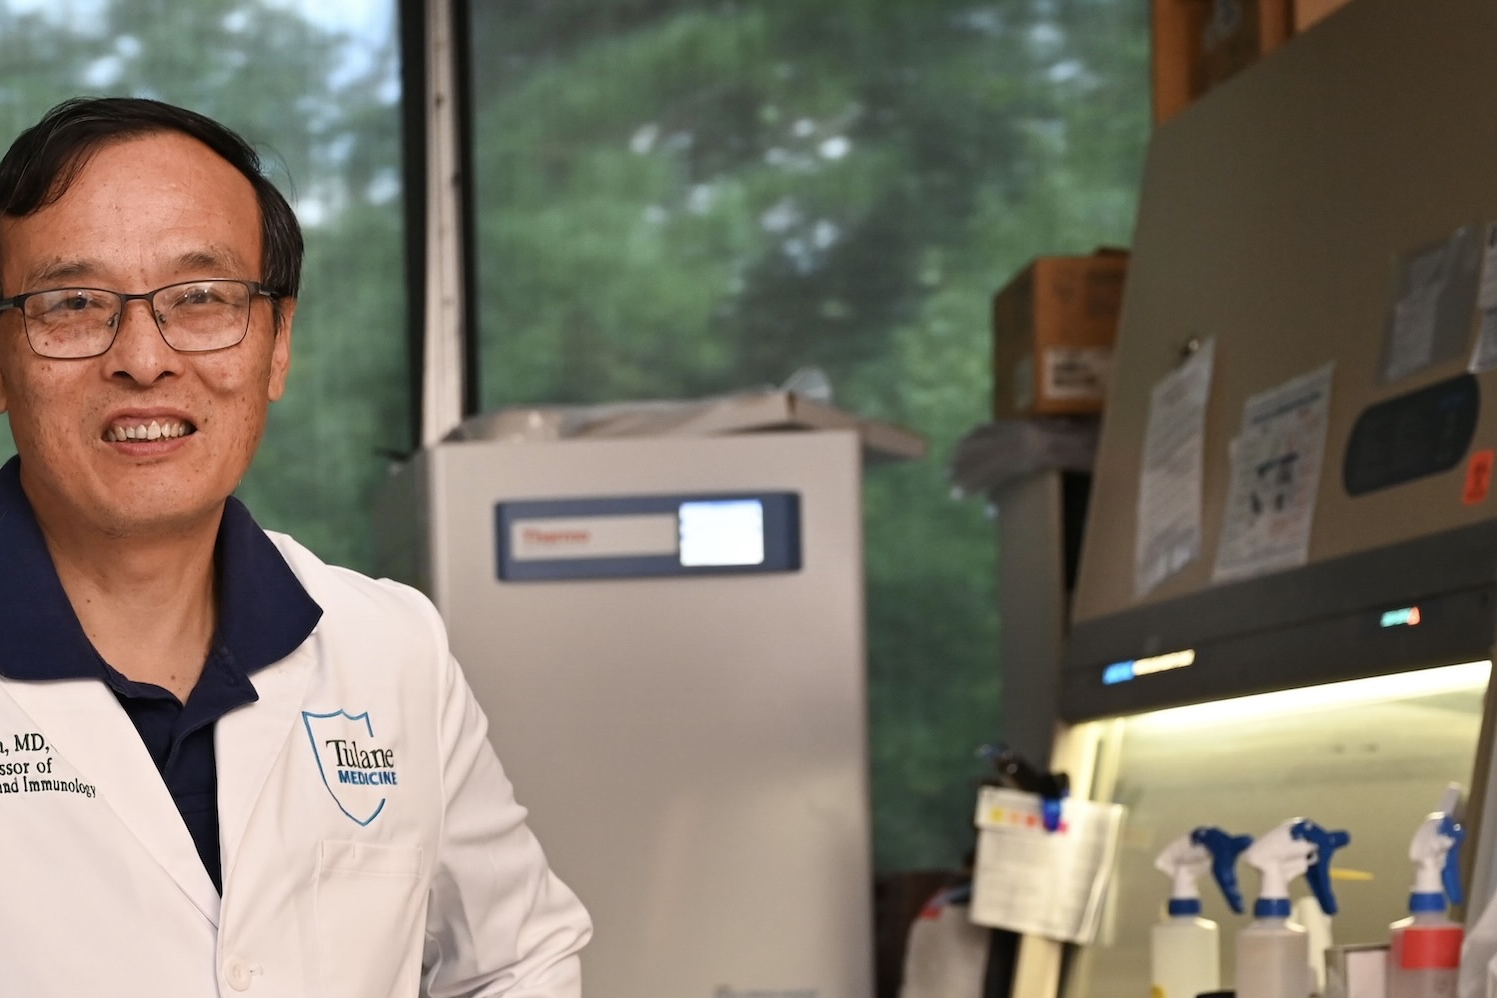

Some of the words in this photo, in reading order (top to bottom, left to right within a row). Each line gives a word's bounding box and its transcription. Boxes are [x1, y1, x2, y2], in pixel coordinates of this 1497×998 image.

[14, 733, 50, 753] MD,
[326, 739, 394, 769] Tulane
[36, 757, 53, 774] of
[23, 776, 96, 798] Immunology
[337, 770, 398, 785] MEDICINE
